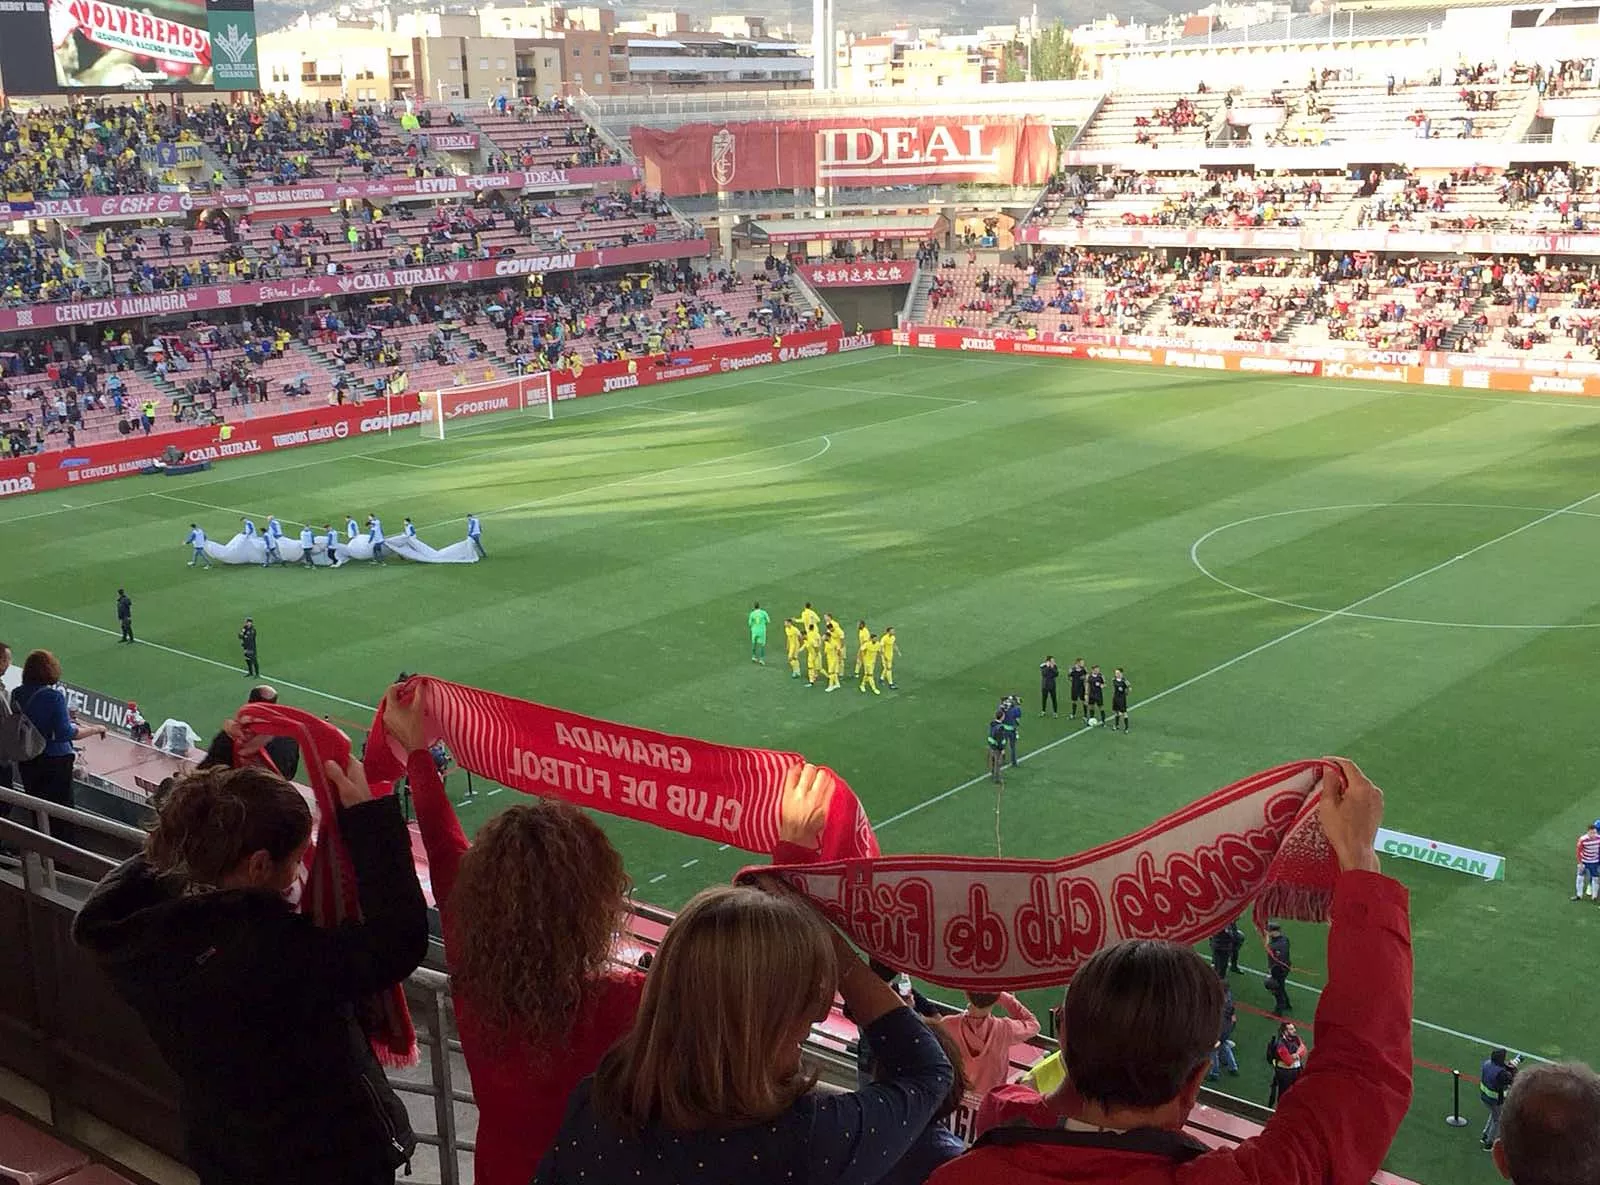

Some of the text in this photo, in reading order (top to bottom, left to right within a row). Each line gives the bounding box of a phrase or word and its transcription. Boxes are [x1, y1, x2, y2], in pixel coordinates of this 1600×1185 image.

[79, 0, 203, 49] VOLVEREMOS
[435, 136, 476, 148] IDEAL
[819, 125, 998, 165] IDEAL
[524, 168, 570, 185] IDEAL
[495, 253, 576, 276] COVIRAN
[353, 267, 445, 290] CAJA RURAL
[55, 302, 118, 323] CERVEZAS
[121, 293, 188, 316] ALHAMBRA
[838, 333, 876, 349] IDEAL
[454, 397, 509, 418] SPORTIUM
[360, 410, 433, 432] COVIRAN
[189, 440, 262, 463] CAJA RURAL
[1383, 839, 1488, 876] COVIRAN
